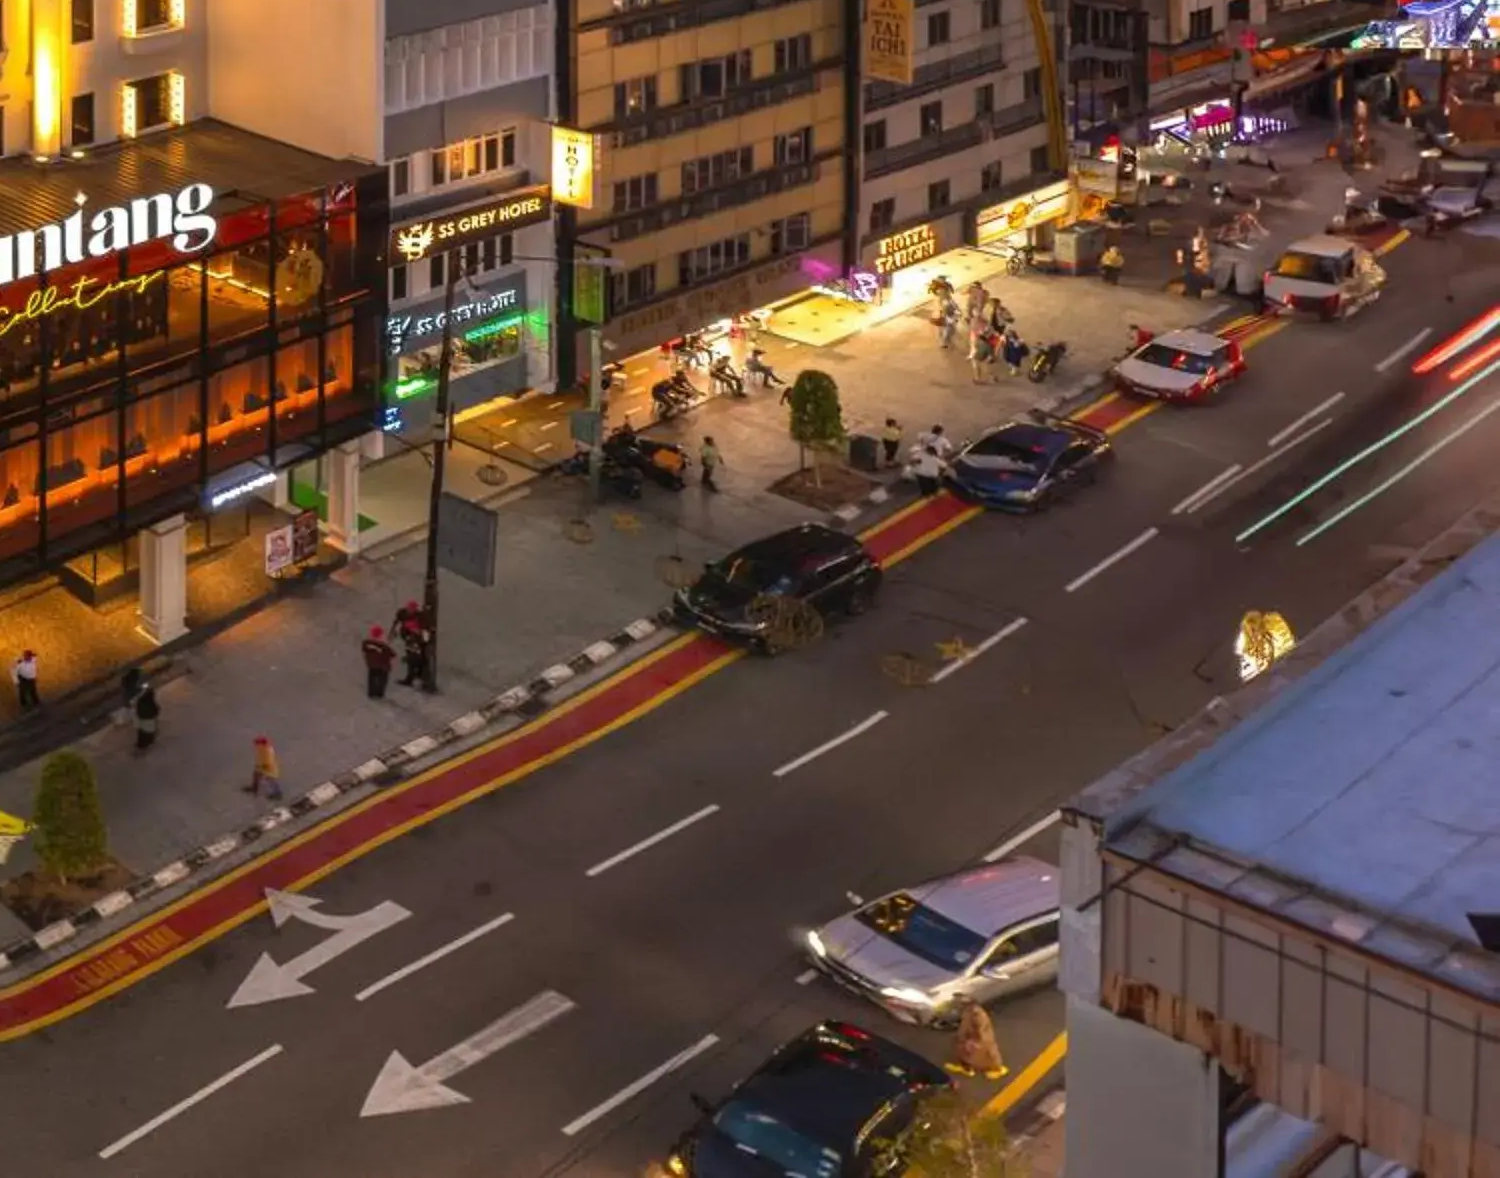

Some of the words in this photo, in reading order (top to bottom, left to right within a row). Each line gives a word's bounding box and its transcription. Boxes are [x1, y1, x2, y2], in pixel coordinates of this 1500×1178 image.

[438, 223, 456, 239] SS
[458, 210, 497, 233] GREY
[498, 198, 541, 221] HOTEL
